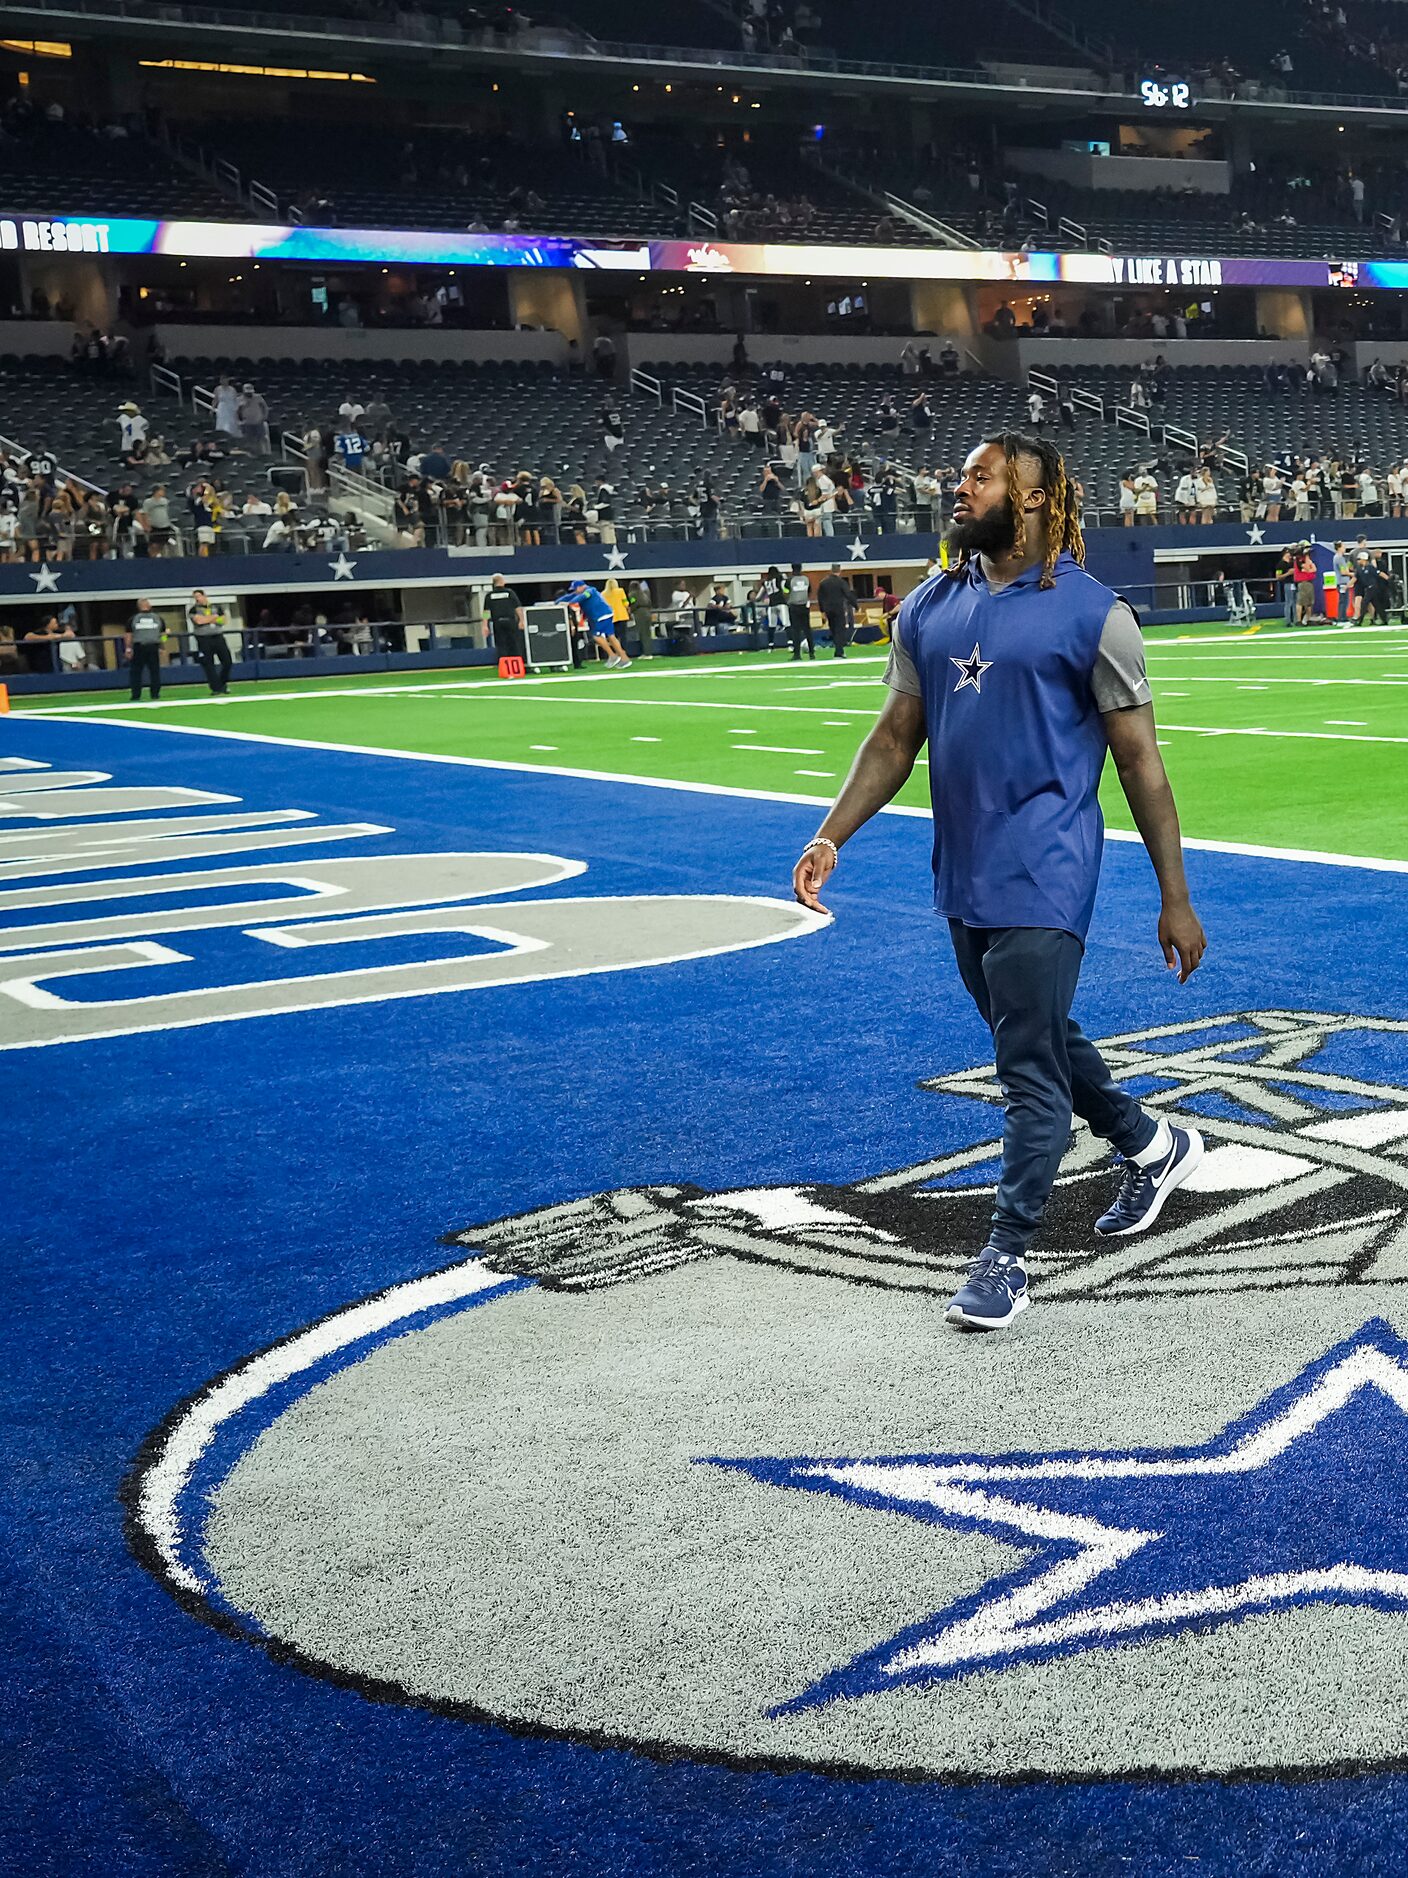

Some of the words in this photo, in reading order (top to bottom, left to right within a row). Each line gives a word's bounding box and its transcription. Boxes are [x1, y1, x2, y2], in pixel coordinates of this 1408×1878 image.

[22, 221, 109, 253] RESORT
[1127, 258, 1163, 285] LIKE
[1166, 260, 1178, 285] A
[1181, 260, 1222, 286] STAR
[345, 438, 363, 454] 12
[30, 460, 51, 475] 90
[504, 659, 521, 675] 10
